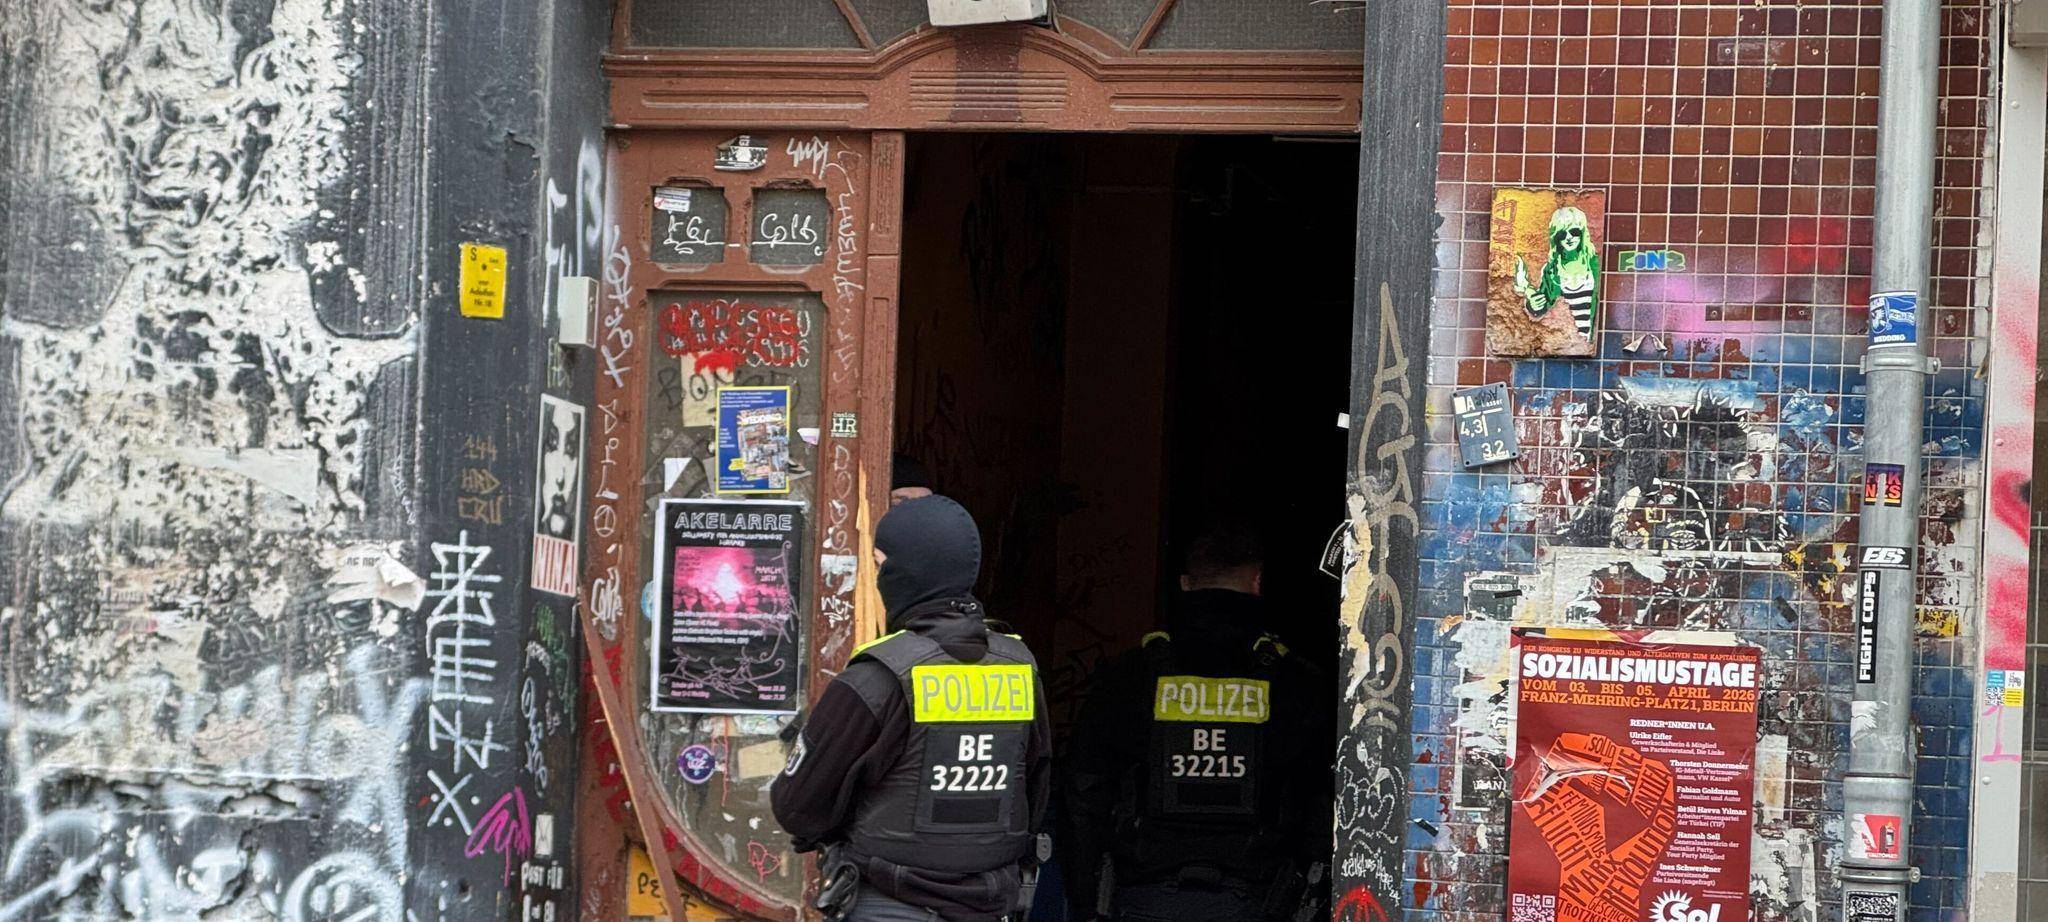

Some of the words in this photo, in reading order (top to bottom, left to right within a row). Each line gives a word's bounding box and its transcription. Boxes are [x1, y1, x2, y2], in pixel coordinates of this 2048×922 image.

[470, 247, 477, 261] S
[832, 418, 858, 432] HR
[1460, 418, 1483, 438] 4,3
[674, 512, 792, 531] AKELARRE
[1862, 571, 1876, 623] COPS
[1538, 646, 1570, 654] KONGRESS
[1584, 648, 1625, 656] WIDERSTAND
[1644, 650, 1690, 659] ALTERNATIVEN
[1710, 654, 1756, 662] KAPITALISMUS
[1859, 626, 1873, 680] FIGHT
[1522, 653, 1756, 688] SOZIALISMUSTAGE
[921, 674, 1030, 713] POLIZEI
[1522, 678, 1556, 692] VOM
[1568, 682, 1588, 694] 03.
[1601, 683, 1624, 694] BIS
[1636, 684, 1656, 696] 05.
[1668, 686, 1710, 699] APRIL
[1723, 689, 1754, 700] 2026
[1160, 682, 1265, 718] POLIZEI
[1702, 700, 1754, 712] BERLIN
[1698, 722, 1715, 730] U.A.
[1193, 728, 1226, 752] BE
[1630, 732, 1652, 740] Ulrike
[1652, 732, 1672, 740] Eifler
[1632, 740, 1684, 748] Gewerkschafterin
[1692, 742, 1716, 750] Mitglied
[958, 734, 994, 762] BE
[1650, 746, 1695, 754] Parteivorstand,
[1171, 754, 1246, 778] 32215
[1670, 760, 1701, 768] Thorsten
[1702, 761, 1749, 770] Donnermeier
[930, 764, 1008, 792] 32222
[1634, 763, 1670, 815] ANTIFA
[1676, 786, 1700, 794] Fabian
[1702, 787, 1738, 796] Goldmann
[1559, 790, 1606, 858] FEMINISMUS
[1710, 820, 1725, 828] (TIP)
[1600, 798, 1676, 919] REVOLUTION
[1682, 852, 1698, 860] Party
[1561, 853, 1623, 908] MARX
[1682, 878, 1716, 886] (angefragt)
[1669, 903, 1721, 922] Sol
